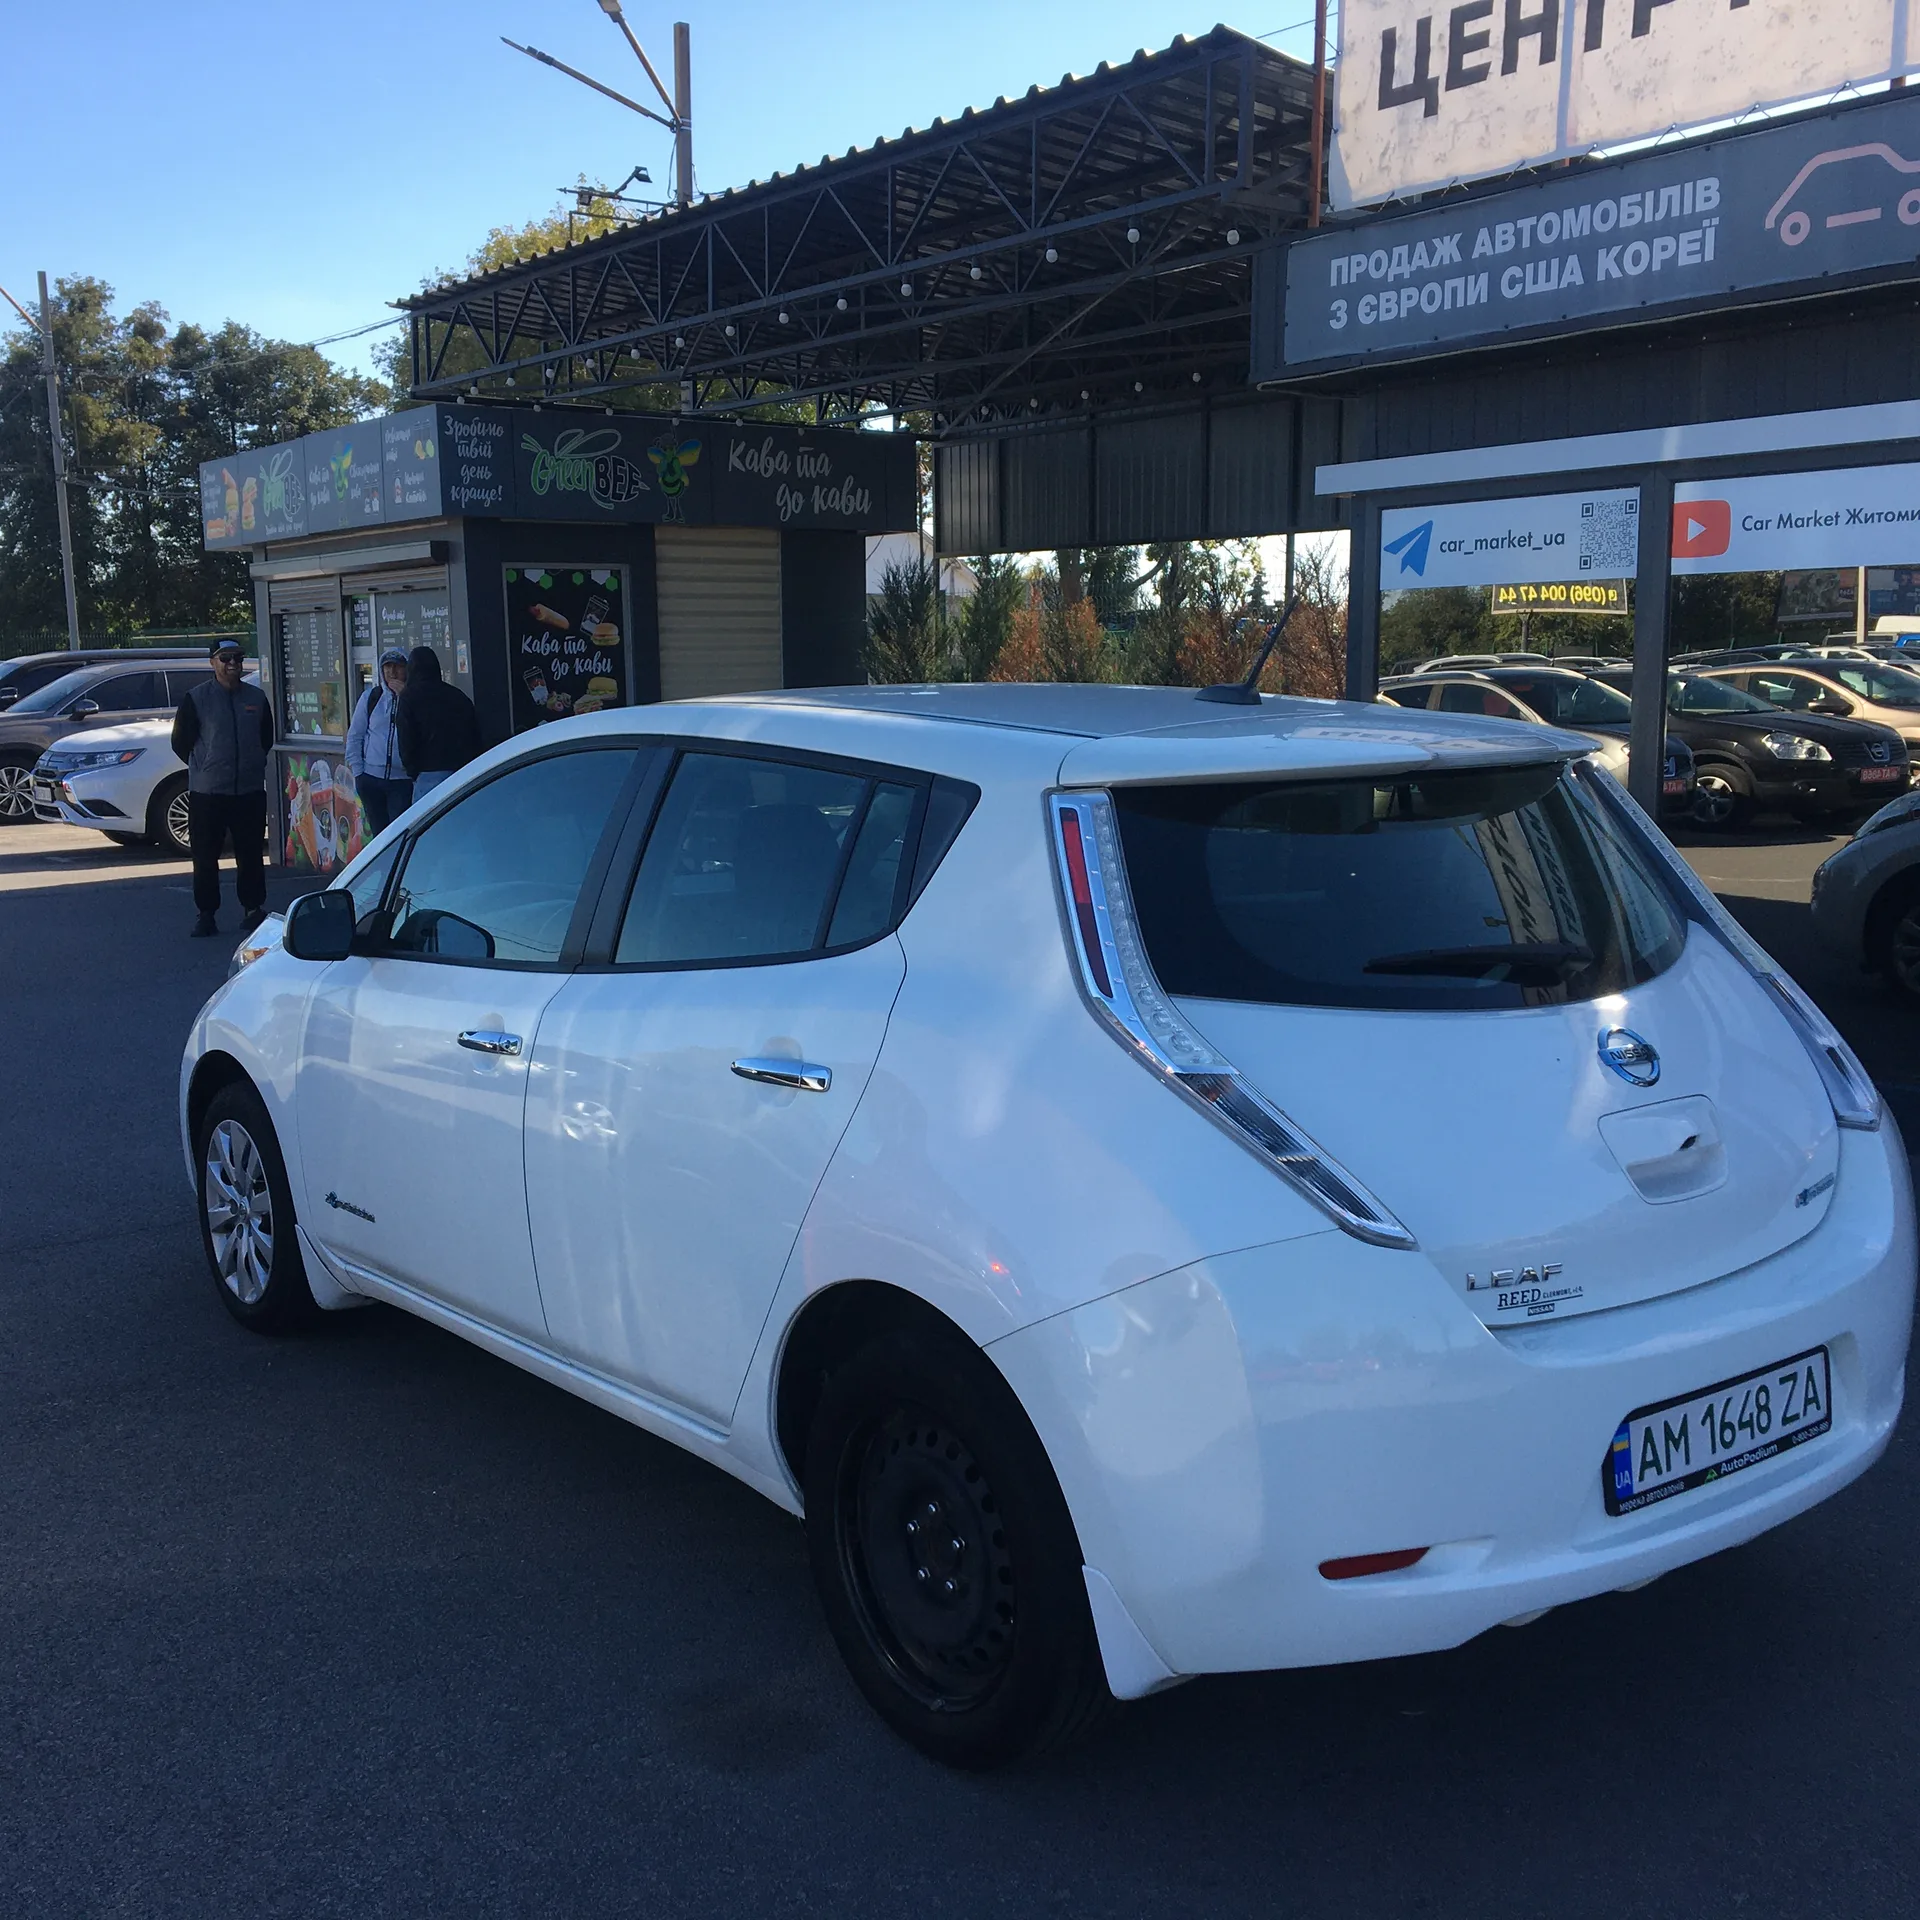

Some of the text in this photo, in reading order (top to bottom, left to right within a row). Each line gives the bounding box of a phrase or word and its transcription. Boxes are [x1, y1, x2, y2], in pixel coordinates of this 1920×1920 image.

[1330, 176, 1721, 287] ПРОДАЖ АВТОМОБІЛІВ
[1329, 216, 1720, 330] З ЄВРОПИ США КОРЕЇ
[444, 415, 504, 443] Зробимо
[458, 439, 494, 459] твій
[728, 436, 833, 478] Кава та
[460, 464, 493, 485] день
[450, 485, 503, 508] краще!
[776, 475, 872, 522] до кави
[1742, 515, 1772, 532] Car
[1776, 509, 1840, 530] Market
[1439, 529, 1565, 555] car_market_ua
[521, 631, 588, 656] Кава та
[551, 651, 613, 681] до кави
[1466, 1262, 1563, 1292] LEAF
[1497, 1288, 1542, 1308] REED
[1528, 1304, 1555, 1316] NISSAN
[1638, 1365, 1822, 1482] AM 1648 ZA
[1720, 1443, 1779, 1474] AutoPodium
[1615, 1470, 1632, 1489] UA
